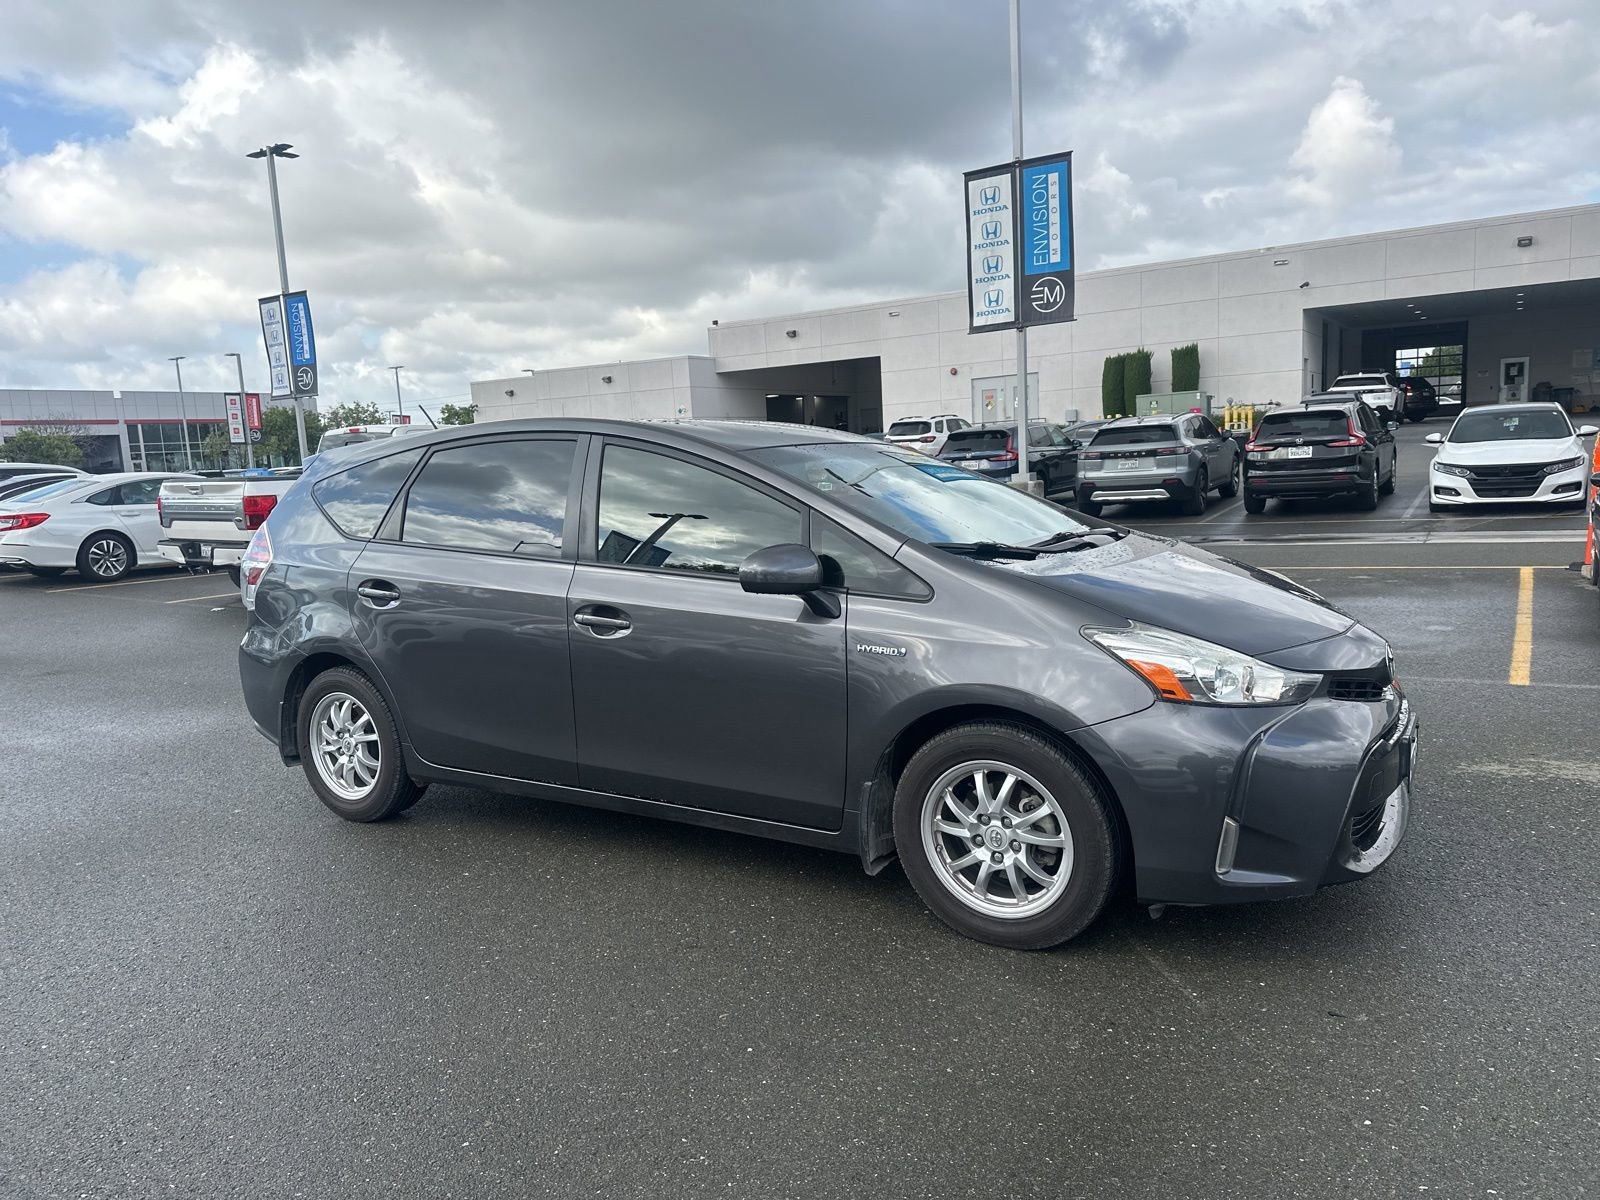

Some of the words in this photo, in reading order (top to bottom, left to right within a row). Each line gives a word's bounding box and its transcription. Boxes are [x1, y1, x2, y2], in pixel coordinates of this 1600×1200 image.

[973, 204, 1009, 216] HONDA
[1032, 173, 1048, 266] ENVISION
[1050, 180, 1059, 256] MOTORS
[974, 239, 1010, 250] HONDA
[975, 273, 1011, 284] HONDA
[976, 307, 1011, 318] HONDA
[291, 303, 304, 360] ENVISION
[857, 644, 897, 656] HYBRID
